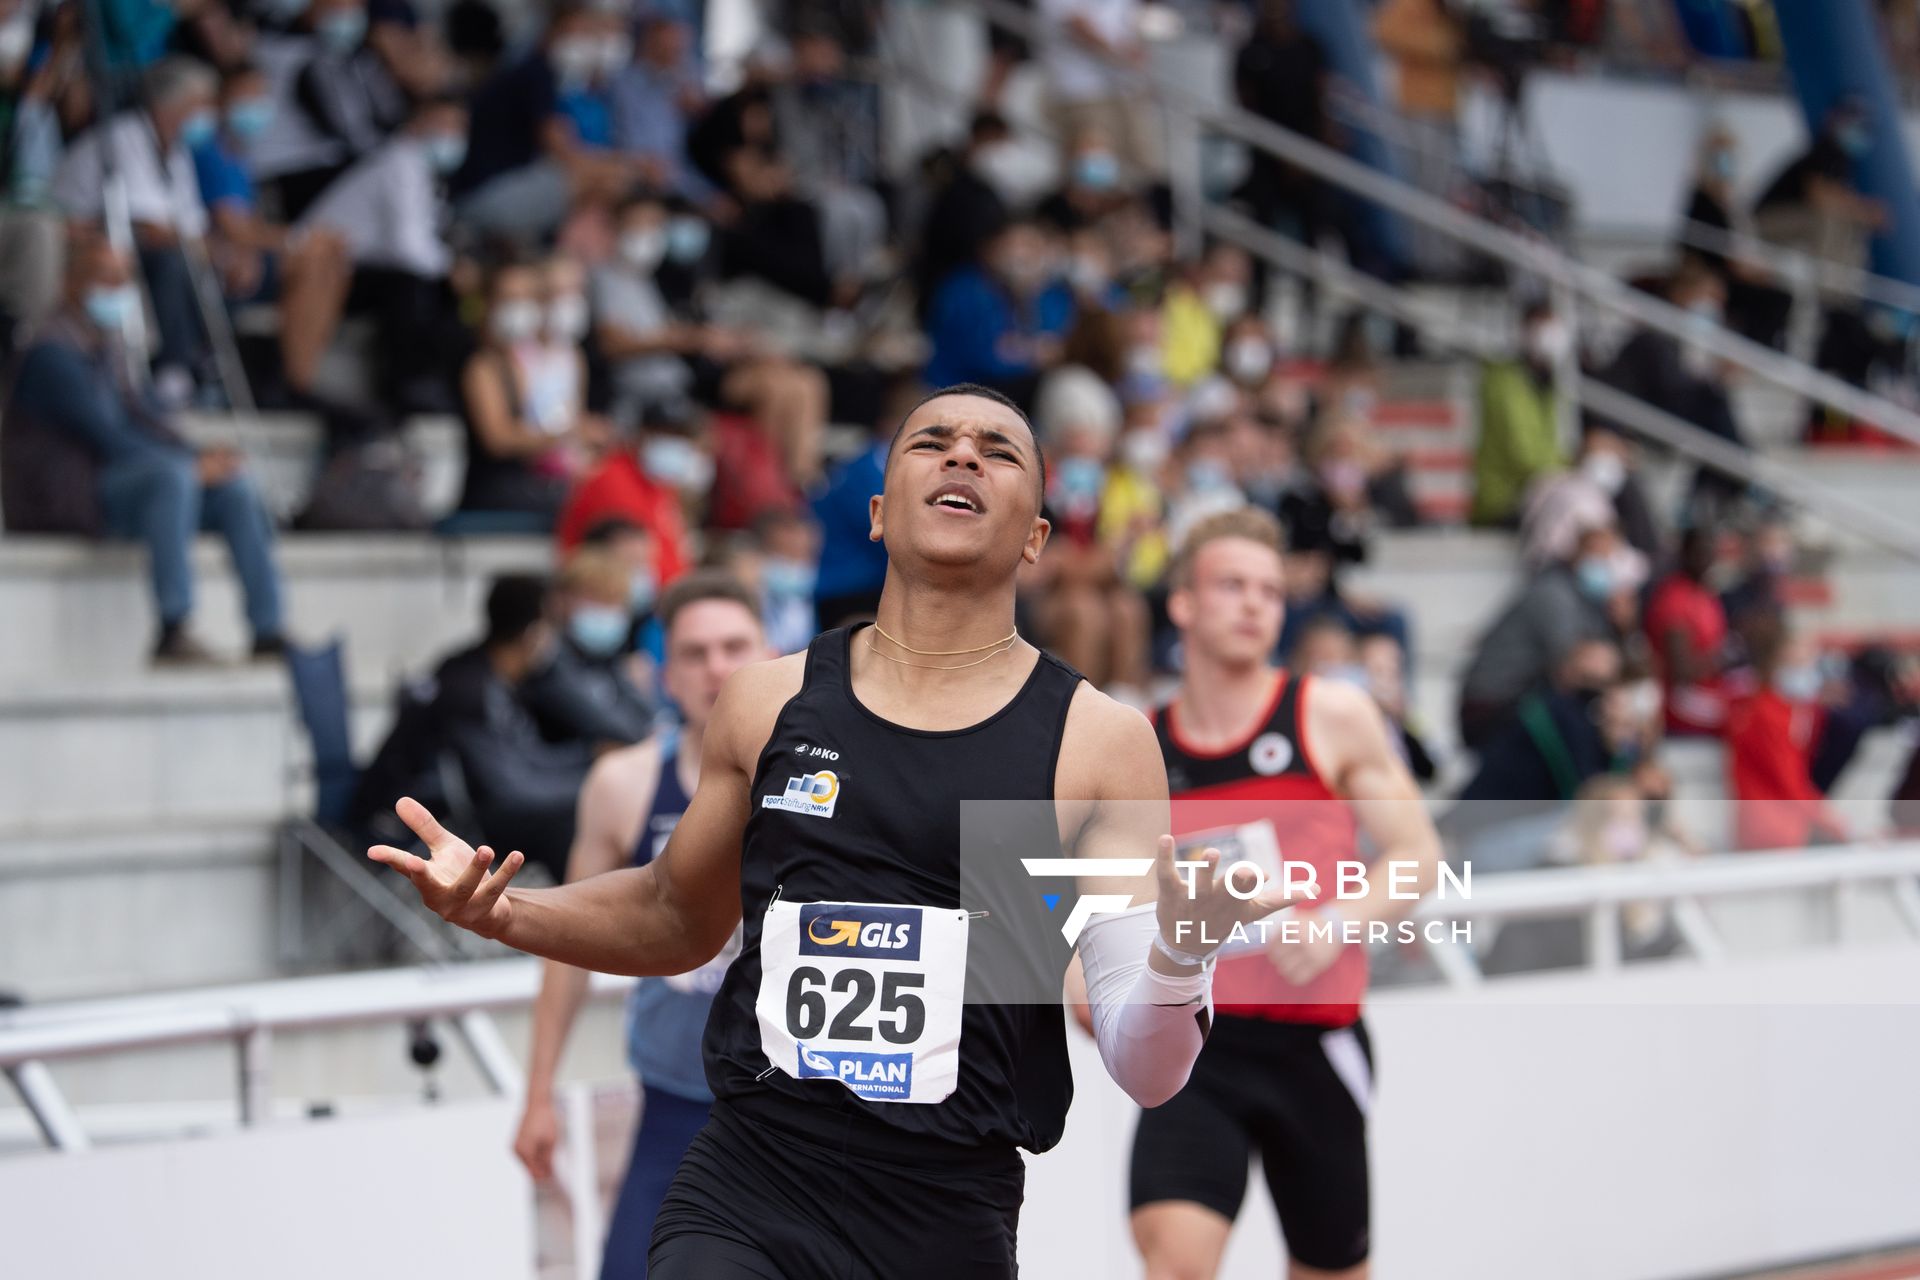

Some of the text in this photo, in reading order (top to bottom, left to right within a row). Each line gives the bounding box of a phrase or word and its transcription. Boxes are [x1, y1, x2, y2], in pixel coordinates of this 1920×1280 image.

[809, 747, 840, 761] JAKO
[859, 922, 911, 950] GLS
[785, 965, 926, 1045] 625
[838, 1059, 907, 1083] PLAN
[848, 1083, 905, 1093] ERNATIONAL
